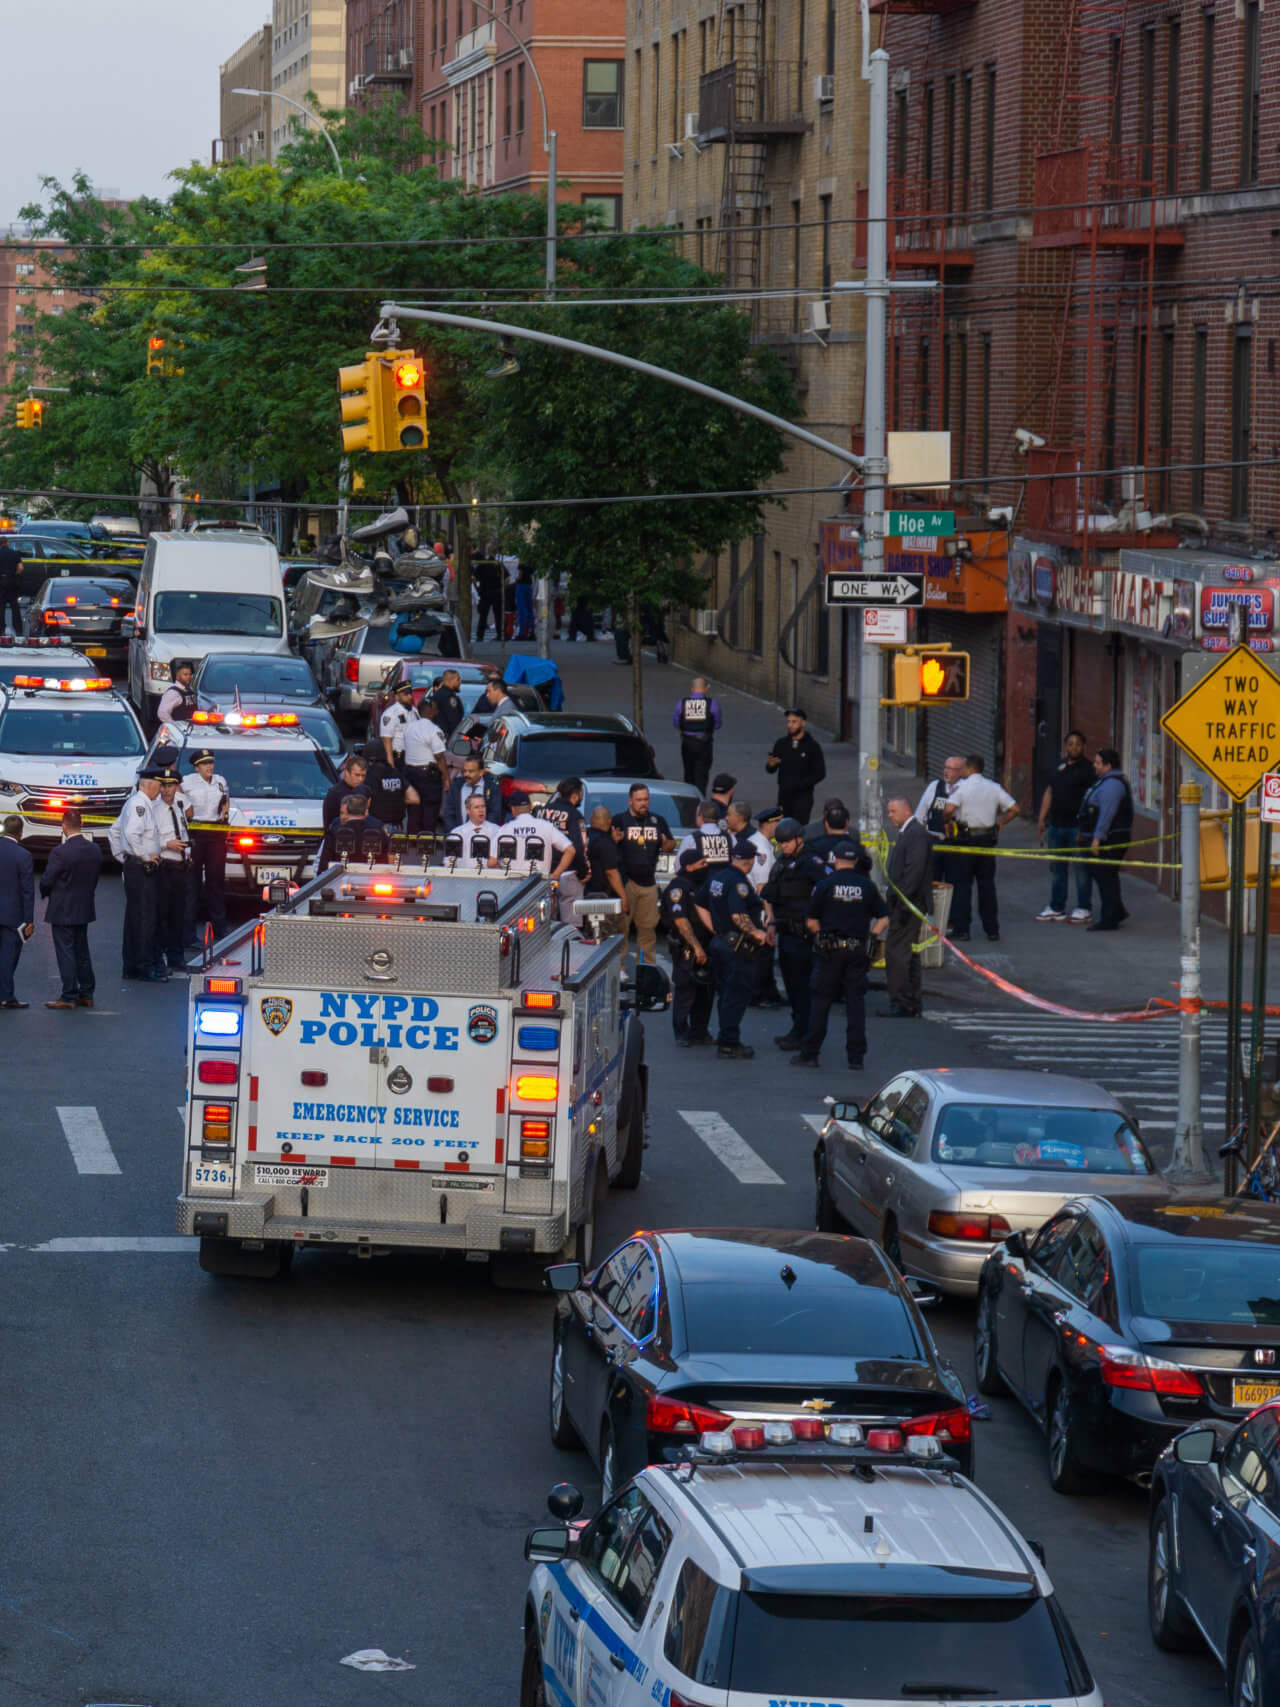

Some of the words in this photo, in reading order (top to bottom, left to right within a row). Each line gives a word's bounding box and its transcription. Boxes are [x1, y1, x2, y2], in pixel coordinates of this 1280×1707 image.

[898, 514, 925, 533] Hoe
[931, 515, 942, 526] Av
[841, 583, 868, 595] ONE
[881, 583, 910, 596] WAY
[1112, 571, 1164, 632] MART
[1224, 676, 1259, 693] TWO
[1224, 699, 1258, 716] WAY
[1205, 722, 1277, 739] TRAFFIC
[1212, 746, 1269, 763] AHEAD
[58, 778, 98, 786] POLICE
[537, 808, 569, 821] NYPD
[249, 818, 297, 827] POLICE
[513, 827, 537, 835] NYPD
[702, 835, 728, 848] NYPD
[703, 847, 729, 858] POLICE
[835, 885, 863, 897] NYPD
[320, 992, 440, 1022] NYPD
[299, 1020, 460, 1051] POLICE
[292, 1102, 388, 1125] EMERGENCY
[393, 1106, 460, 1128] SERVICE
[276, 1131, 326, 1141] KEEP
[333, 1134, 384, 1144] BACK
[391, 1137, 426, 1147] 200
[433, 1139, 480, 1149] FEET
[195, 1168, 227, 1182] 5736
[256, 1166, 290, 1176] $10,000
[292, 1168, 327, 1177] REWARD
